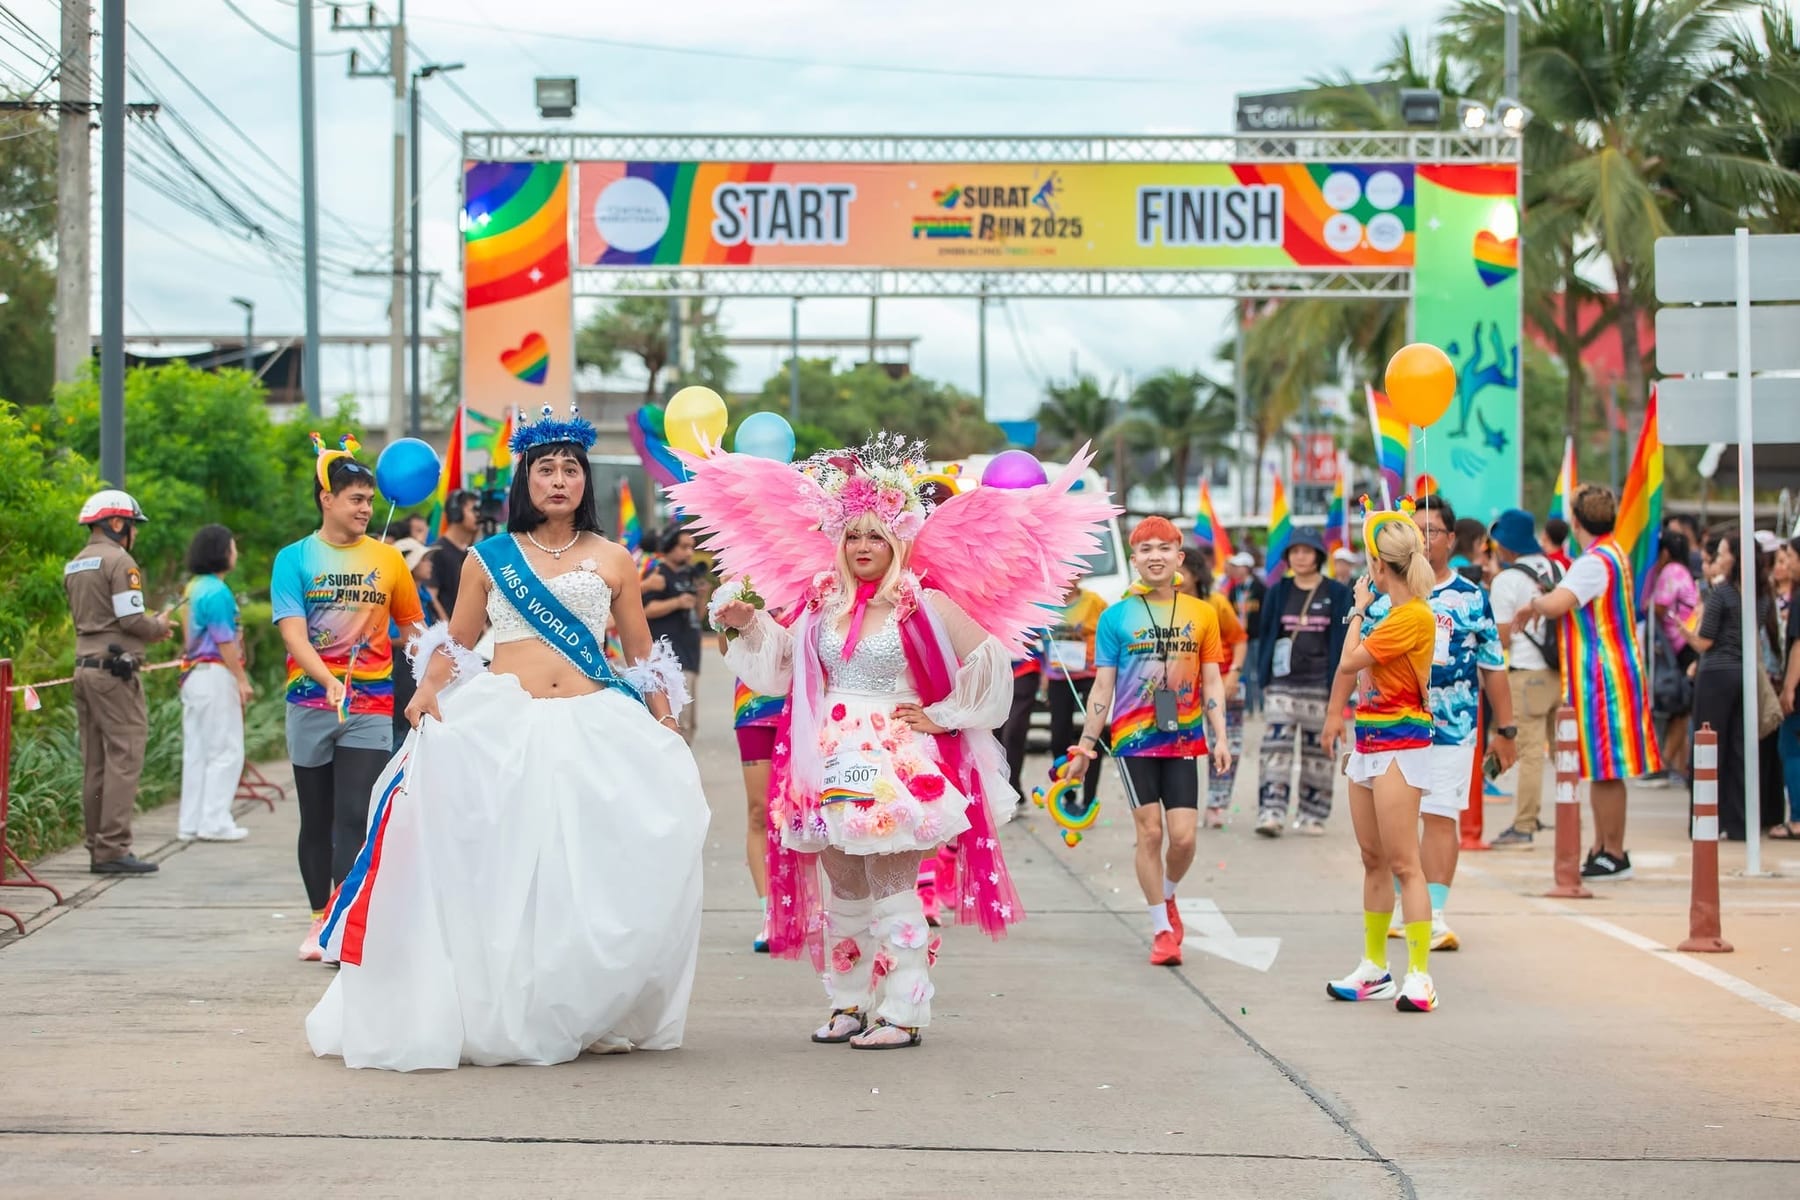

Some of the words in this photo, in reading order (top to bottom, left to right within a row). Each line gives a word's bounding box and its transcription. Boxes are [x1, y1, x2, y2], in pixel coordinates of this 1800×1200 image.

[963, 186, 1030, 208] SURAT
[717, 187, 851, 240] START
[1142, 190, 1277, 241] FINISH
[978, 213, 1025, 239] RUN
[1031, 217, 1082, 238] 2025
[328, 573, 364, 586] SURAT
[335, 589, 360, 603] RUN
[362, 590, 387, 605] 2025
[500, 564, 529, 599] MISS
[527, 598, 580, 646] WORLD
[1180, 641, 1198, 653] 202
[844, 769, 878, 783] 5007
